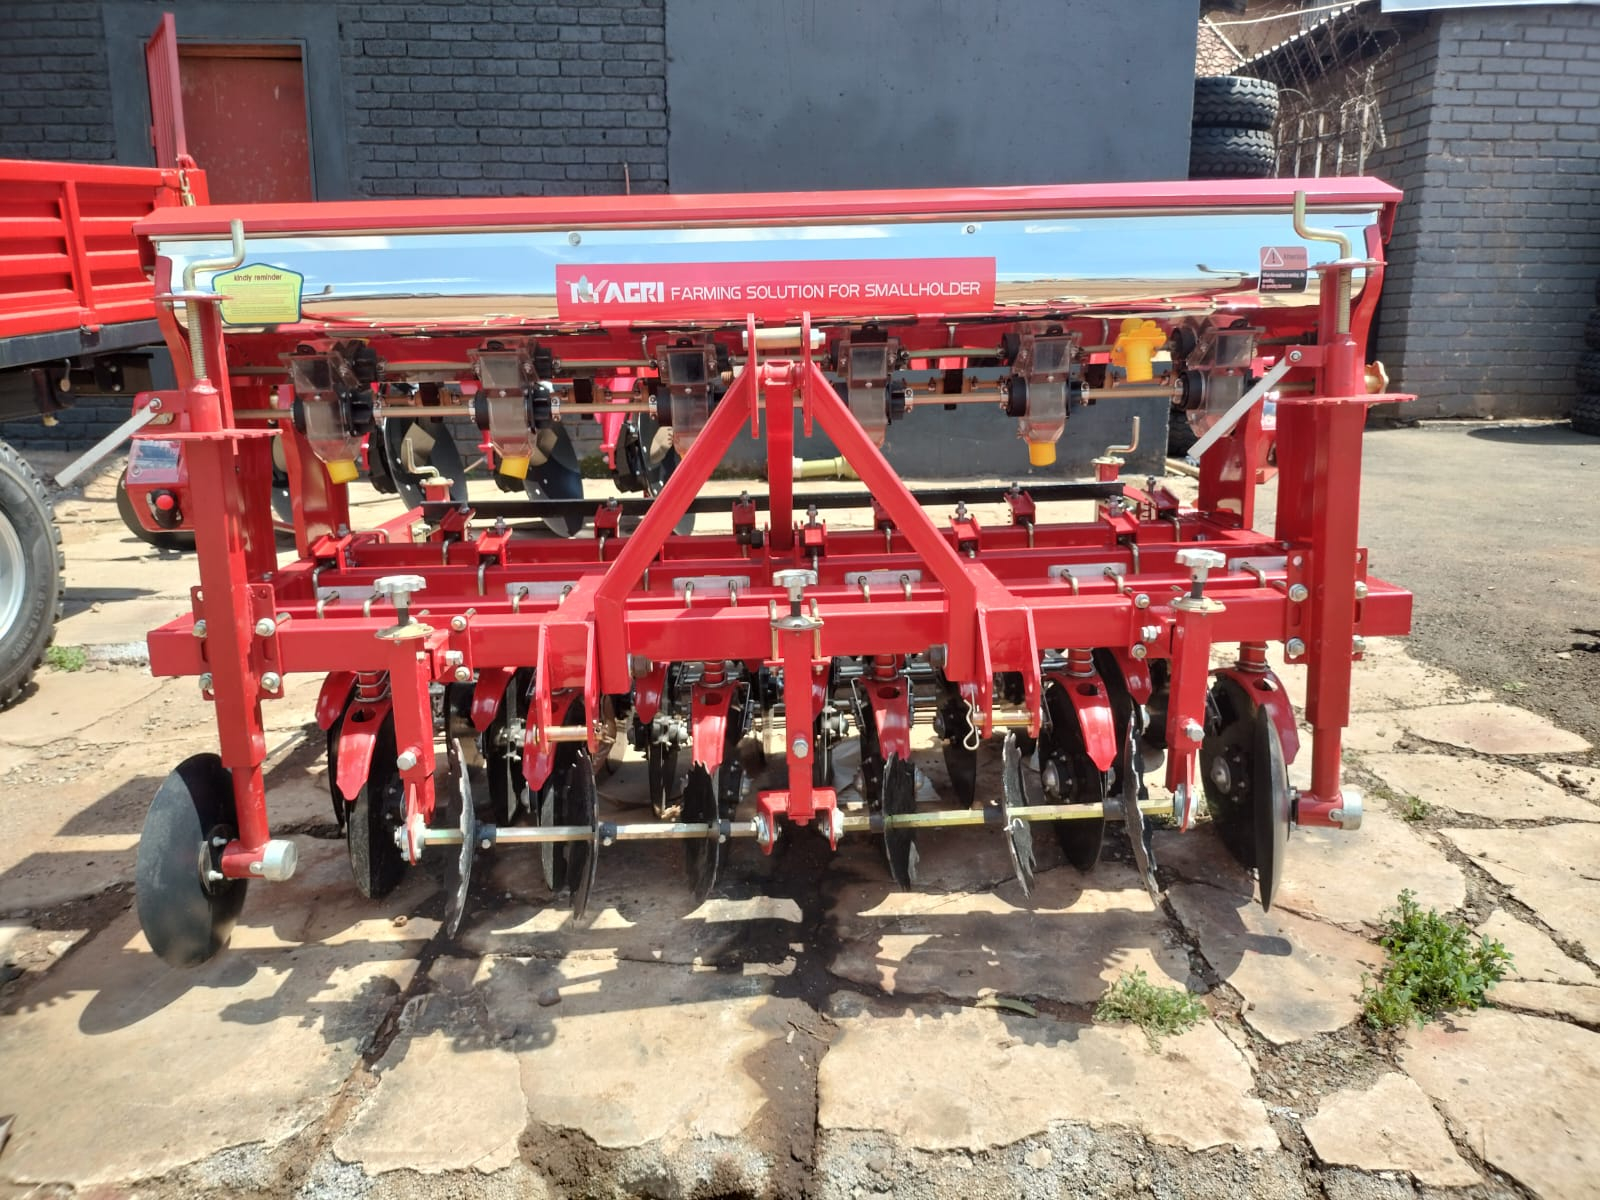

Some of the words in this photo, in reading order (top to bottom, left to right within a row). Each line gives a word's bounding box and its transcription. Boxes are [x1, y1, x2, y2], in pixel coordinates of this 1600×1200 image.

[233, 274, 253, 283] kindly
[254, 273, 282, 281] reminder
[670, 286, 742, 301] FARMING
[746, 284, 824, 300] SOLUTION
[828, 284, 860, 299] FOR
[864, 281, 981, 298] SMALLHOLDER
